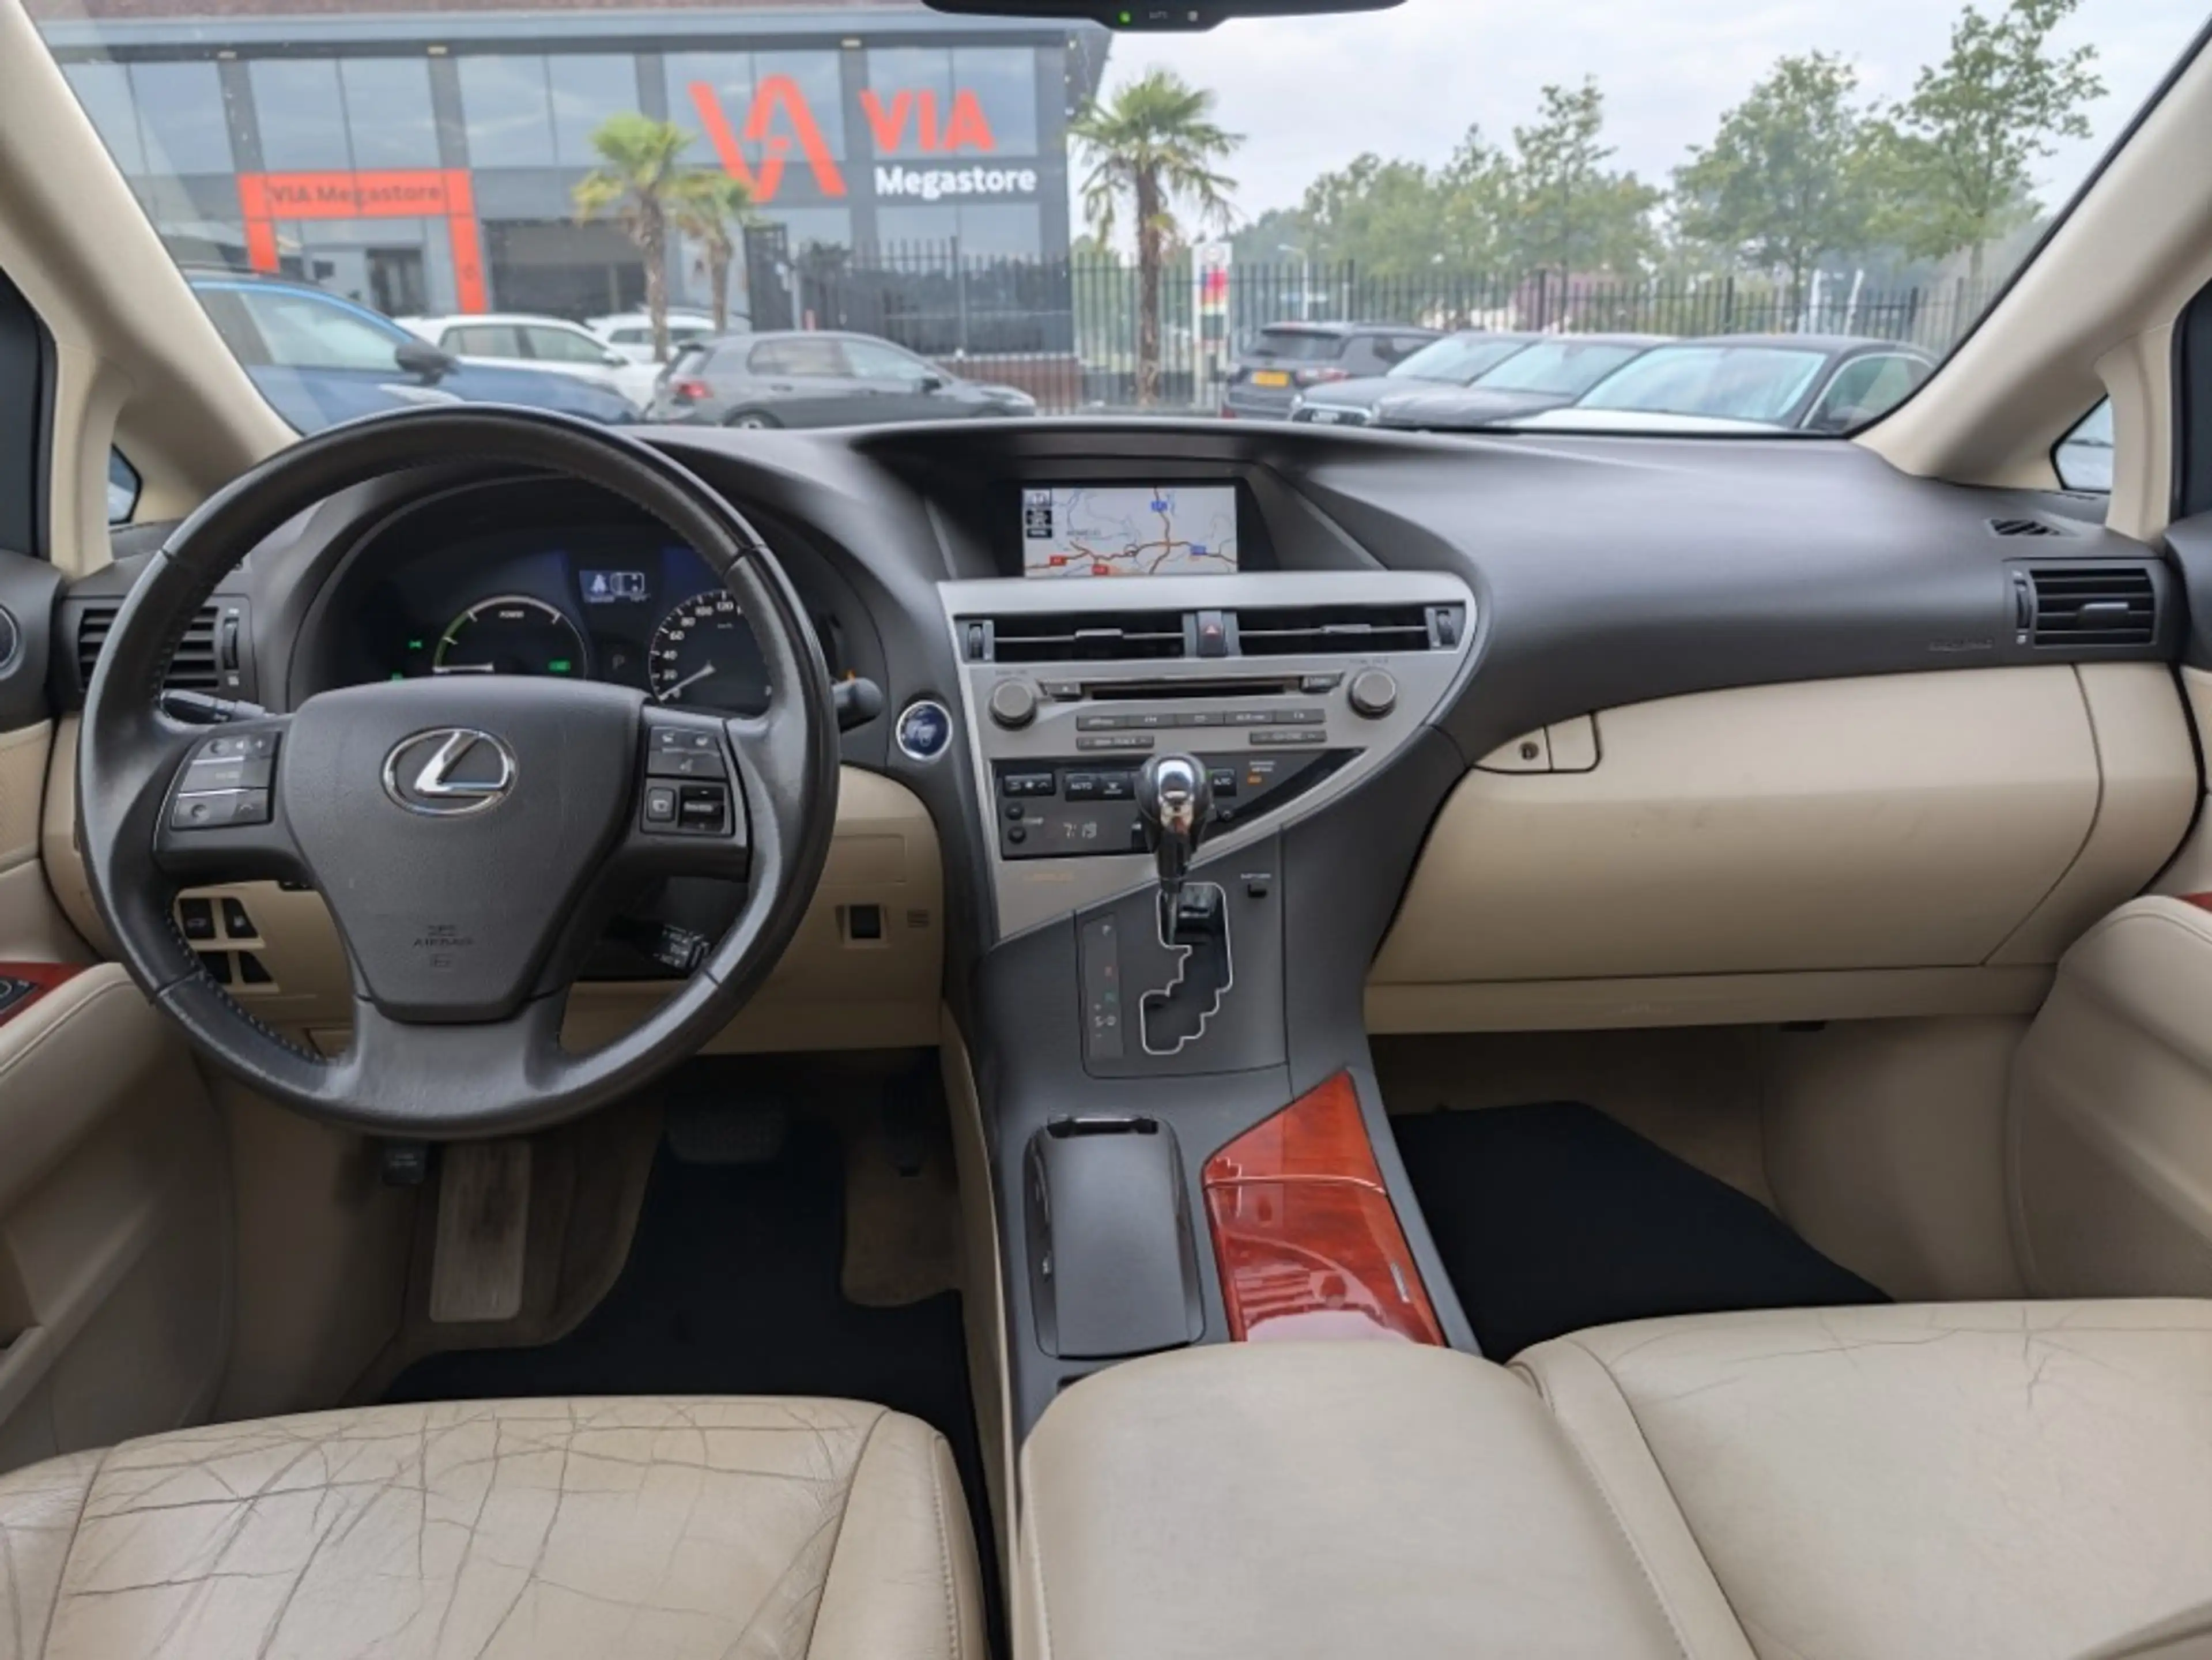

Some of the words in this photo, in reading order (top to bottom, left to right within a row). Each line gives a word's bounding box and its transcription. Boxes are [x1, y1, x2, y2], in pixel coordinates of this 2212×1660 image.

[859, 88, 997, 153] VIA
[874, 165, 1037, 201] Megastore
[270, 185, 309, 205] VIA
[316, 183, 443, 210] Megastore
[670, 630, 685, 640] 60
[663, 650, 678, 660] 40
[663, 669, 678, 680] 20
